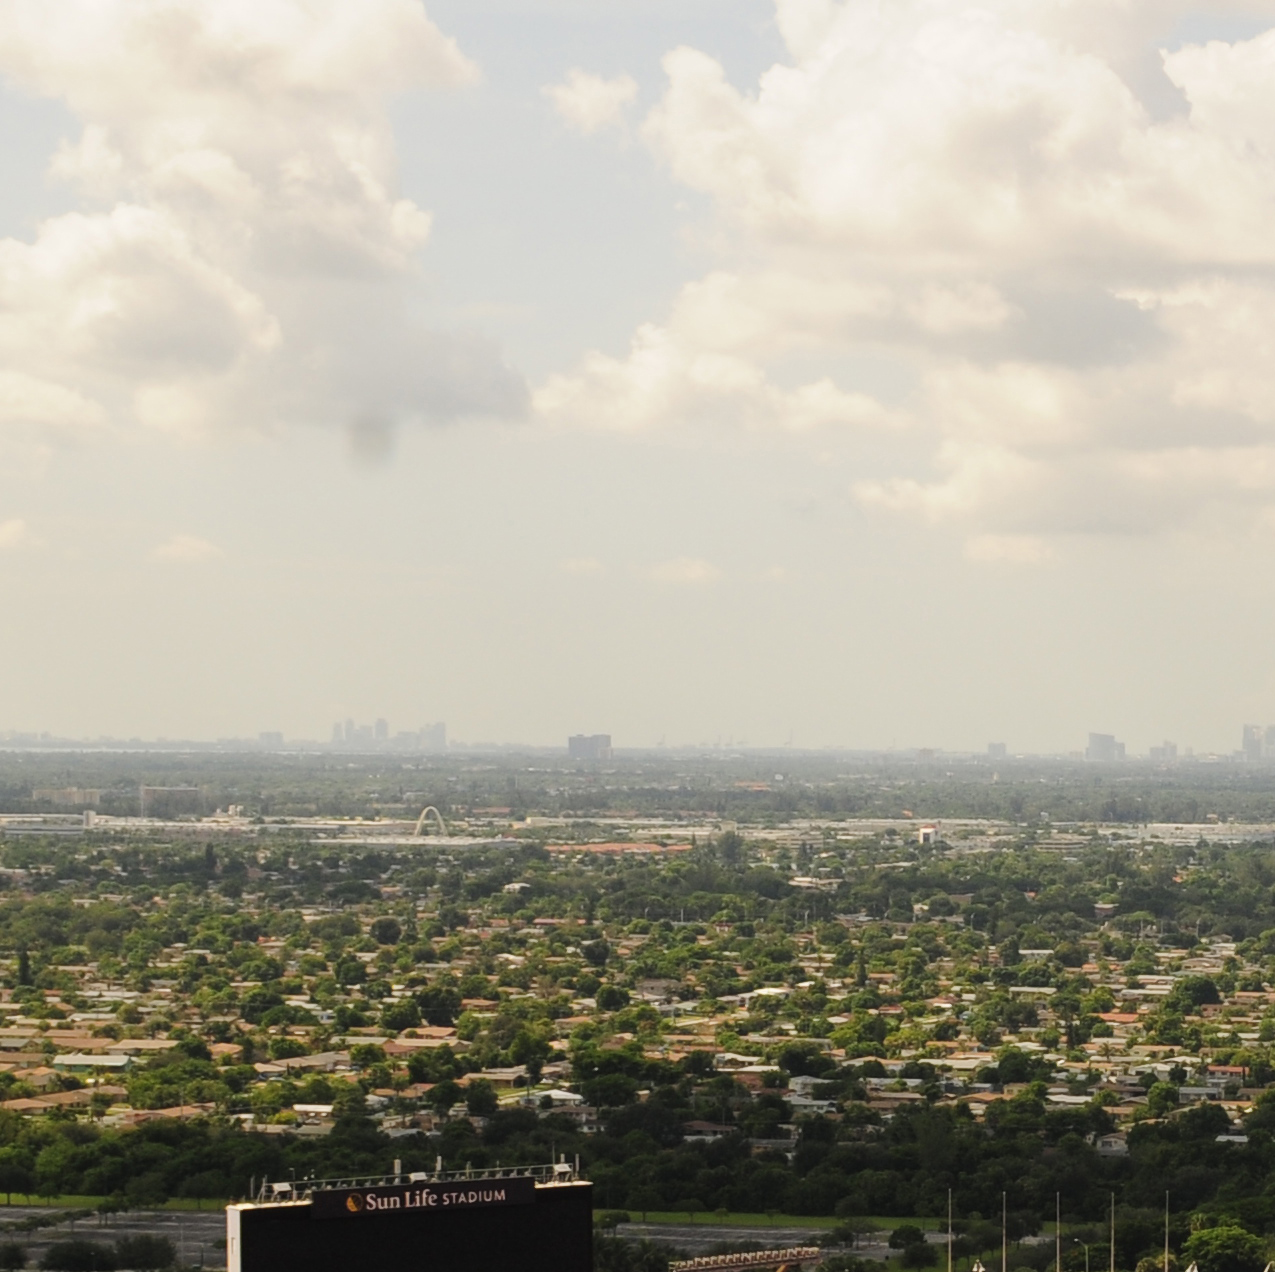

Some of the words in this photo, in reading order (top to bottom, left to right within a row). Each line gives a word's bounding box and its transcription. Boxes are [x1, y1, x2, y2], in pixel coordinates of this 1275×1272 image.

[366, 1193, 400, 1210] Sun
[404, 1189, 438, 1208] Life
[442, 1189, 506, 1205] STADIUM
